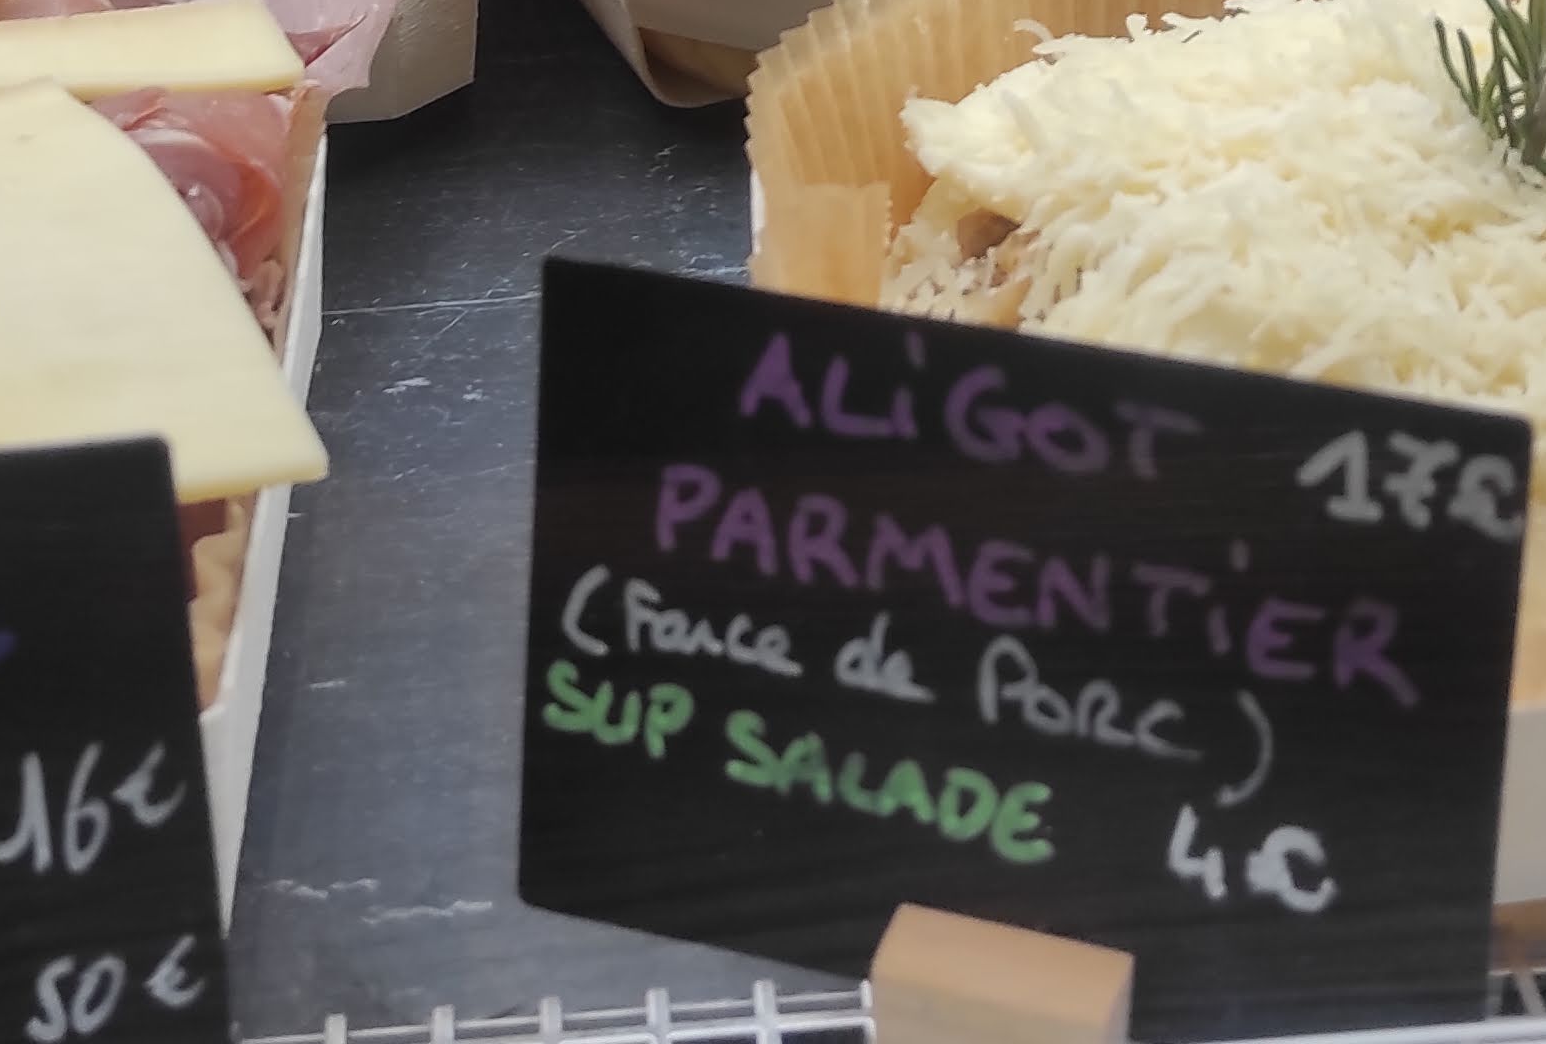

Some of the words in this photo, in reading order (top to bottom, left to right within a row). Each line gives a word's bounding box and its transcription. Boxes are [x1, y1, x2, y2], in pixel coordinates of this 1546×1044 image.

[1296, 430, 1525, 542] 17€
[835, 612, 937, 704] de
[543, 661, 695, 758] SUP
[723, 710, 1053, 862] SALADE
